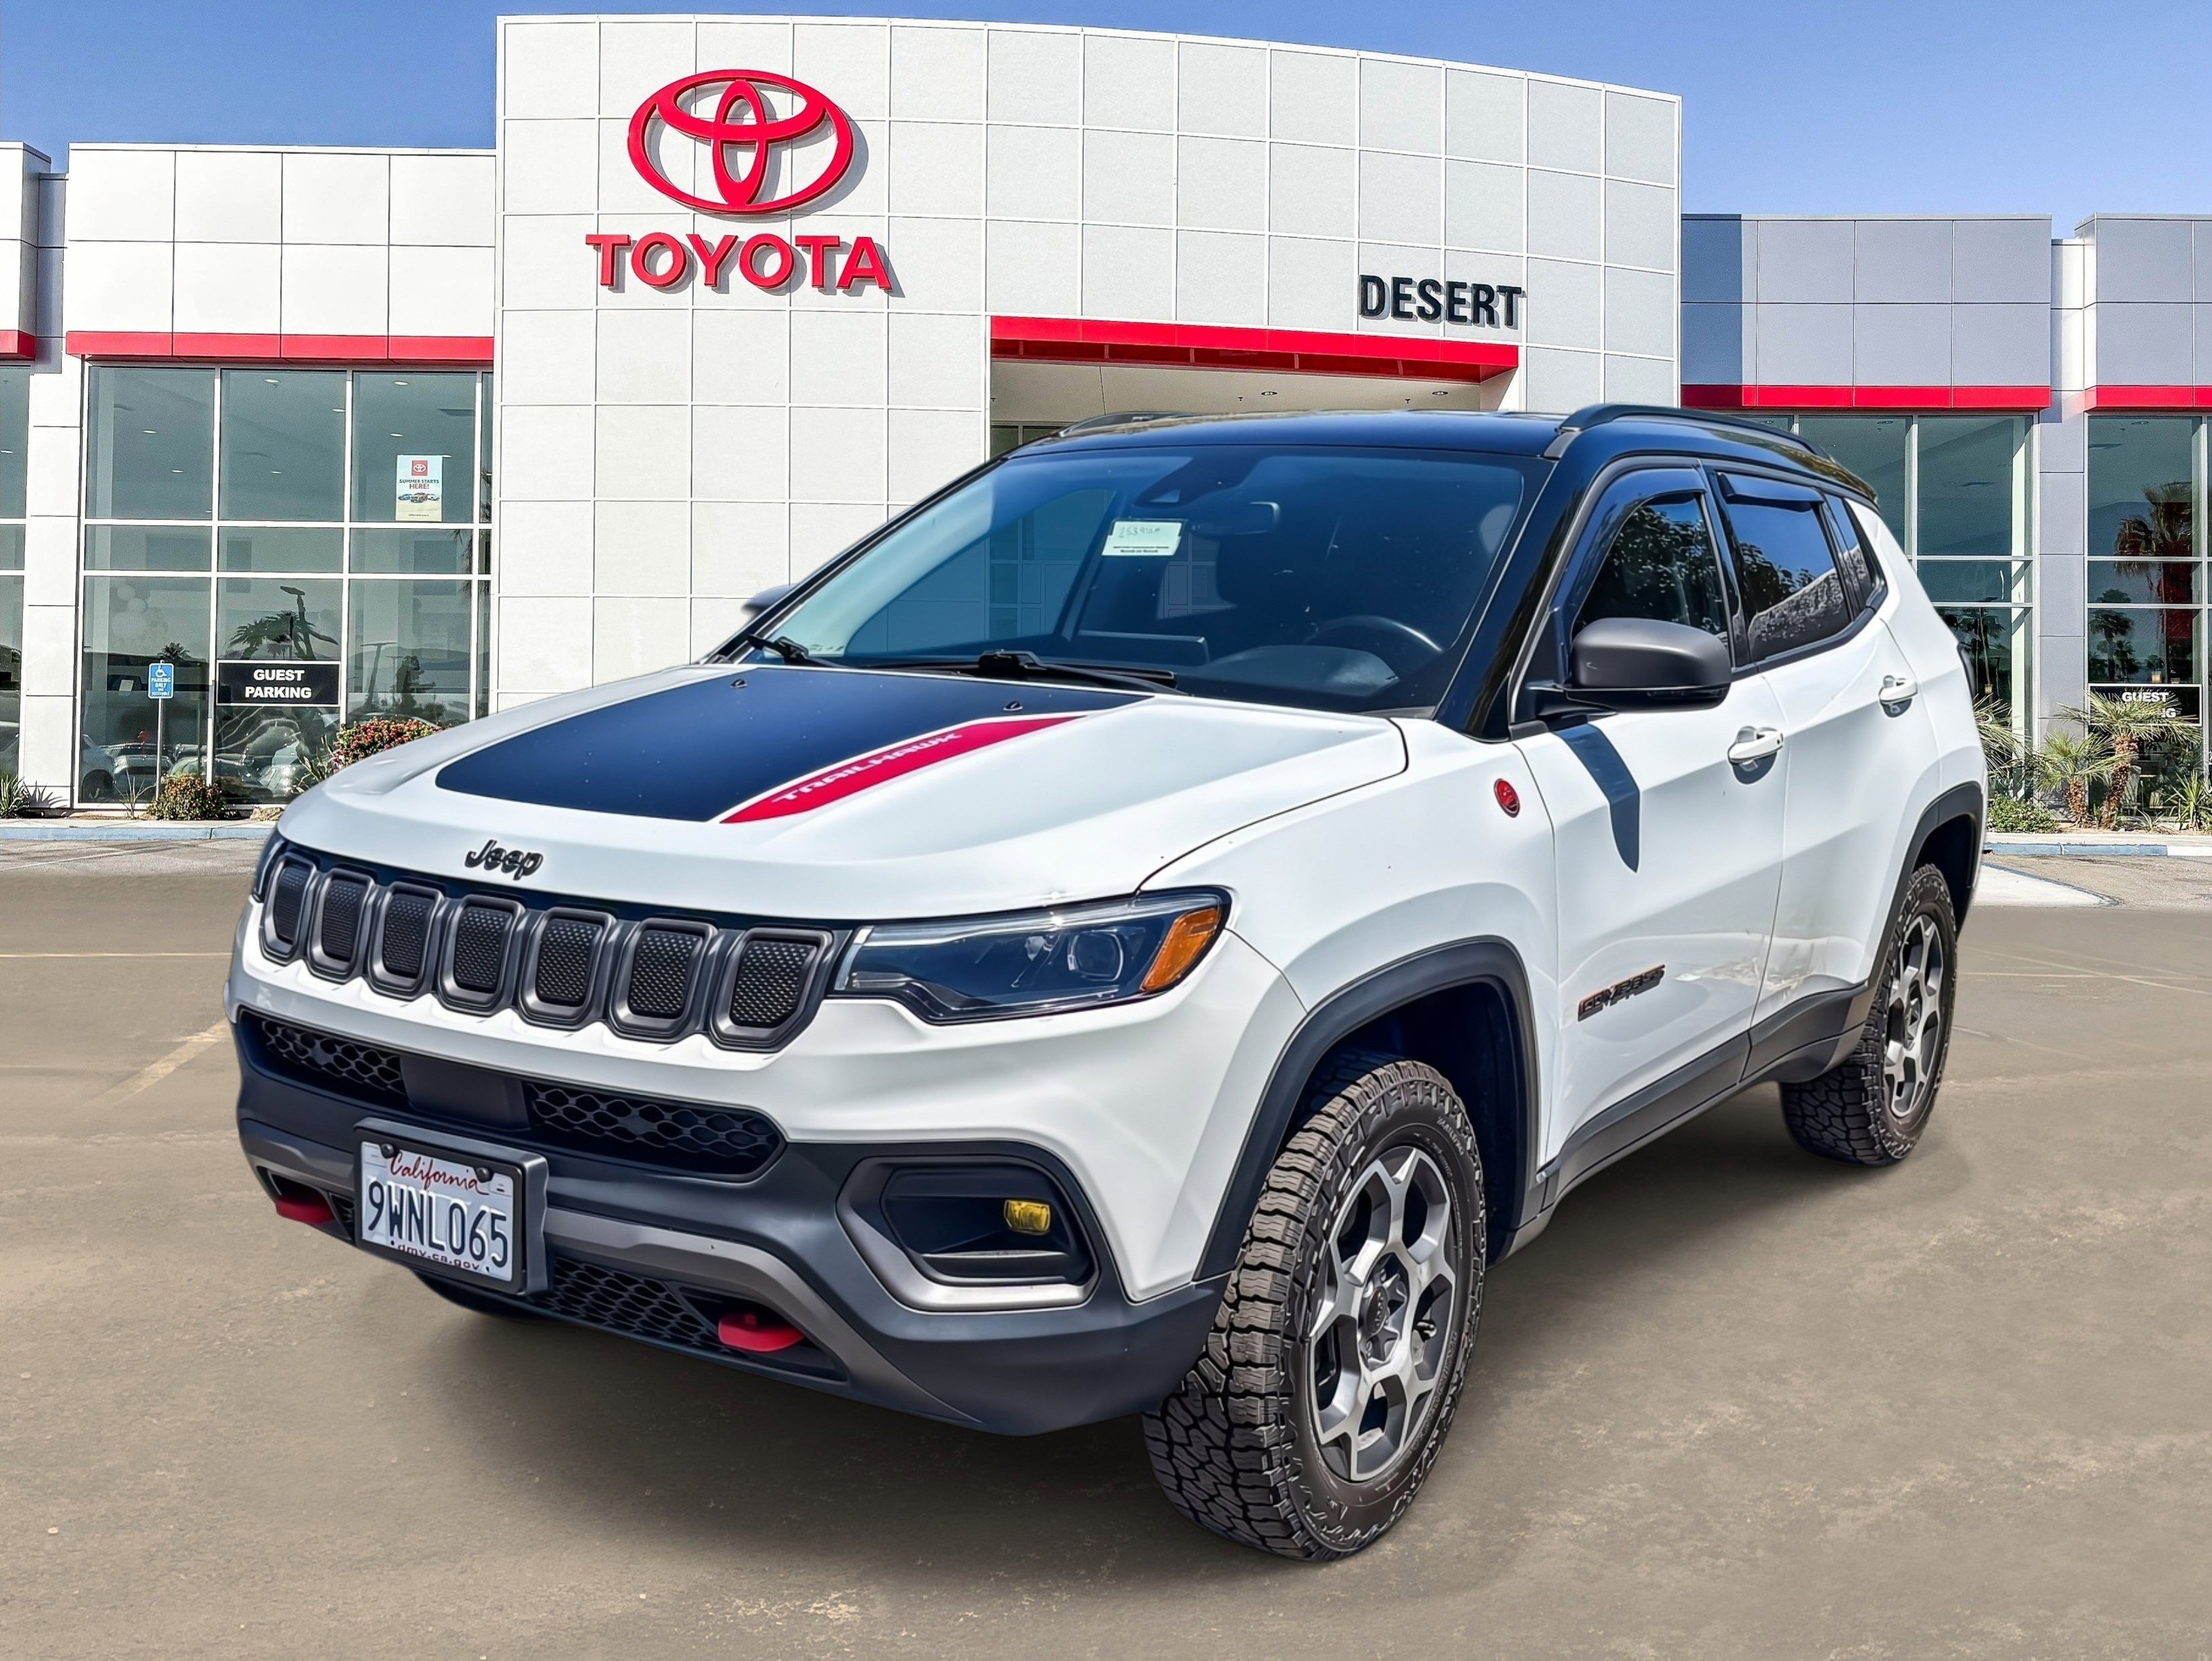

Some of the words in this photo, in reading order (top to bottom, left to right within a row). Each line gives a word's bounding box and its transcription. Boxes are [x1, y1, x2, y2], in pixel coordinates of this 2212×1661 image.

[585, 232, 893, 290] TOYOTA
[1358, 274, 1522, 326] DESERT
[245, 686, 312, 699] PARKING
[253, 668, 305, 681] GUEST
[2121, 691, 2170, 703] GUEST
[771, 732, 963, 804] TRAILHAWK
[464, 839, 544, 881] Jeep
[390, 1151, 490, 1195] California
[368, 1180, 508, 1268] 9WNL065
[398, 1243, 480, 1270] dmv.ca.gov
